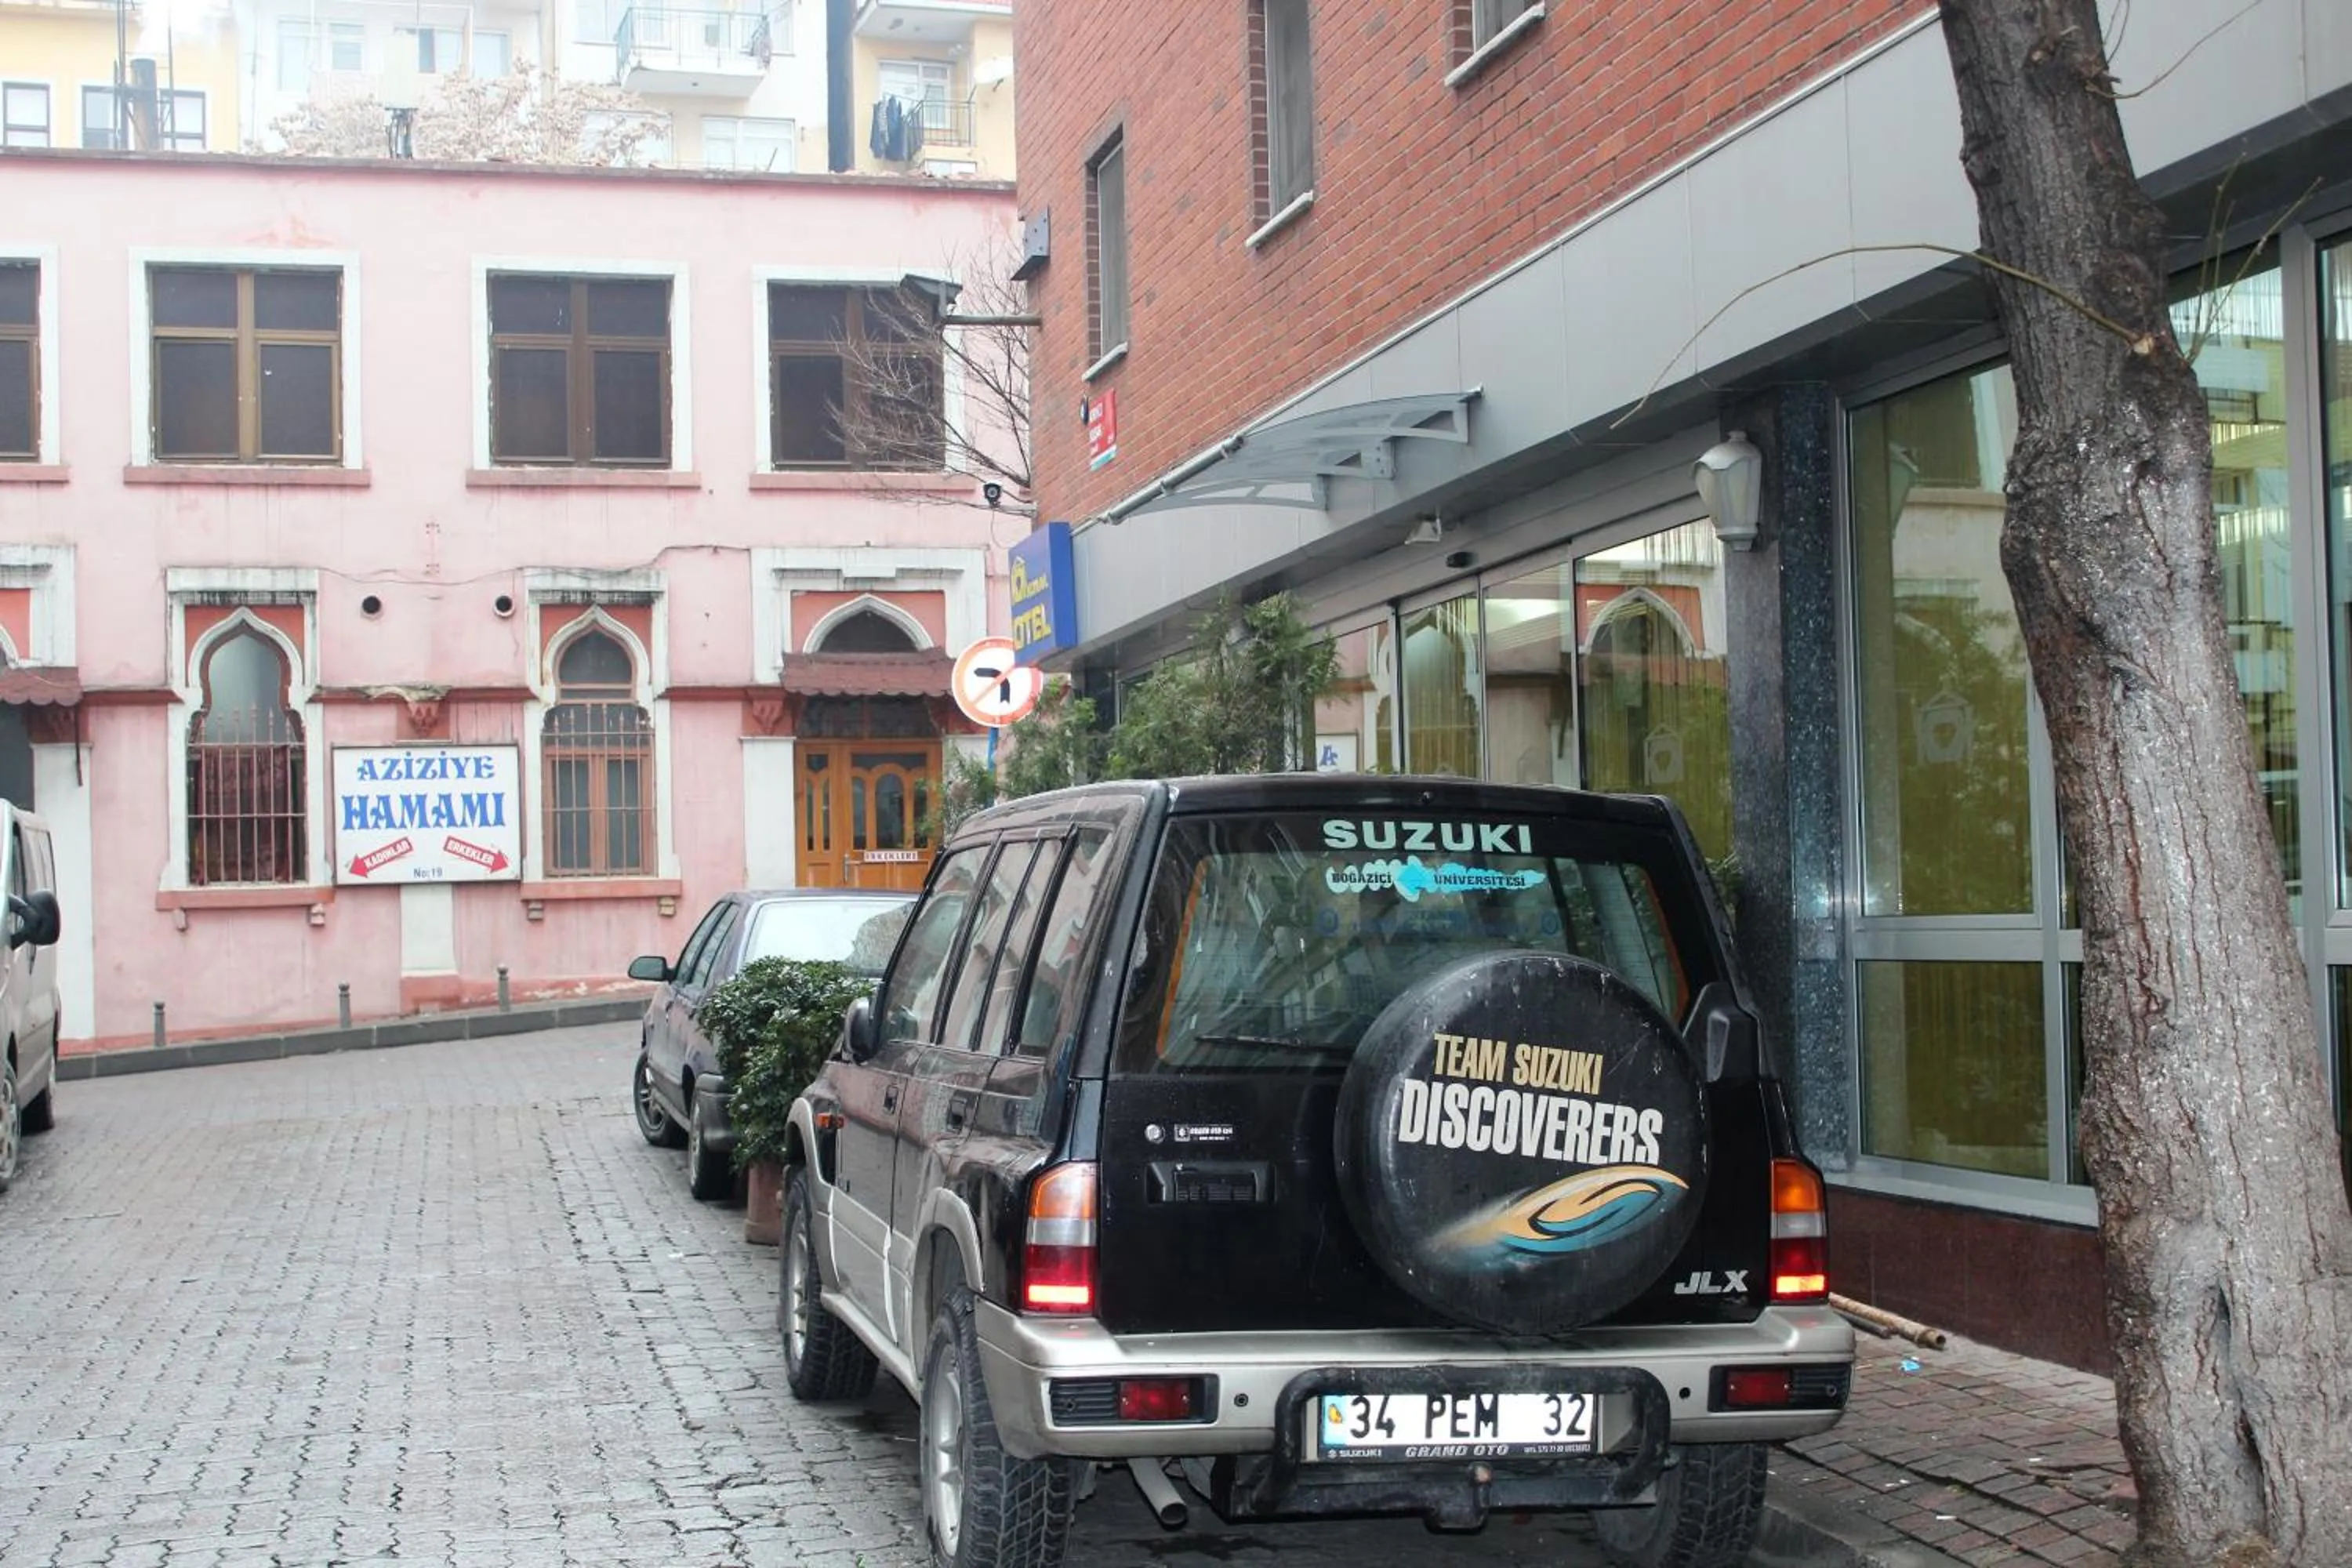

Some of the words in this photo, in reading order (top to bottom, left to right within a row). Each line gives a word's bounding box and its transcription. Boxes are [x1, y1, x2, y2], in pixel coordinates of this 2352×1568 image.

[1013, 603, 1051, 650] OTEL
[357, 750, 495, 782] AZİZİYE
[341, 791, 506, 830] HAMAMI
[447, 839, 495, 866] ERKEKLER
[1323, 819, 1533, 854] SUZUKI
[1433, 1033, 1508, 1083] TEAM
[1512, 1043, 1604, 1096] SUZUKI
[1398, 1078, 1664, 1166] DISCOVERERS
[1674, 1269, 1749, 1294] JLX
[1349, 1395, 1396, 1439] 34
[1425, 1394, 1499, 1439] PEM
[1543, 1394, 1586, 1436] 32
[1339, 1448, 1382, 1458] SUZUKI
[1404, 1445, 1468, 1458] GRAND
[1472, 1444, 1509, 1457] OTO
